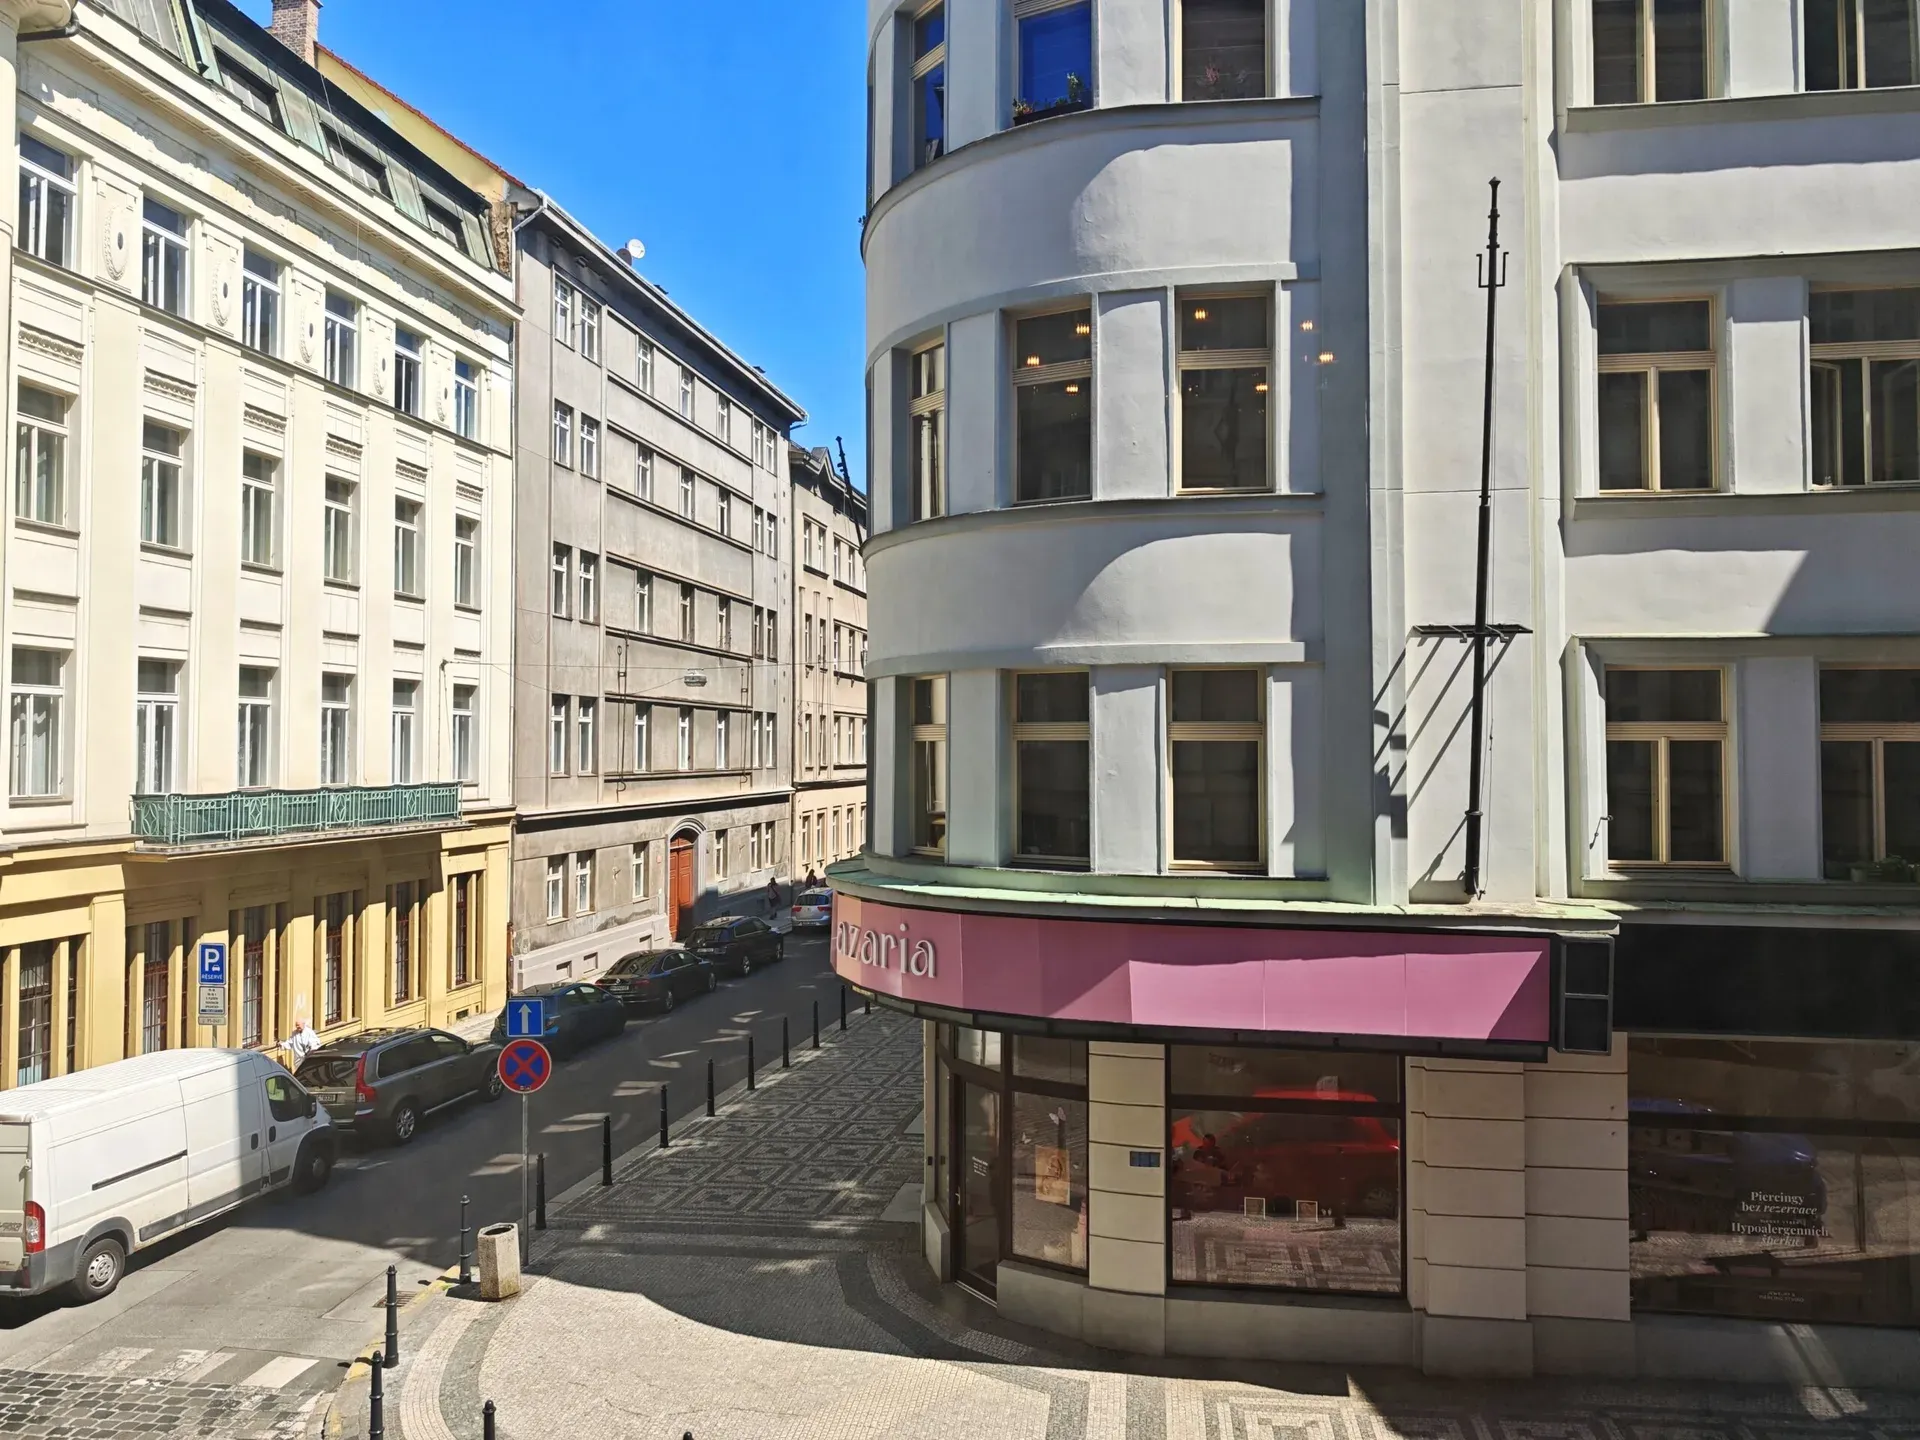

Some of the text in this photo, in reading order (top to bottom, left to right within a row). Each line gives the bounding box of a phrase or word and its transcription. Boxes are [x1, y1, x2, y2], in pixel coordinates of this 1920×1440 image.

[204, 948, 220, 971] P
[1750, 1191, 1805, 1205] Piercingy
[1741, 1201, 1818, 1215] bez rezervace
